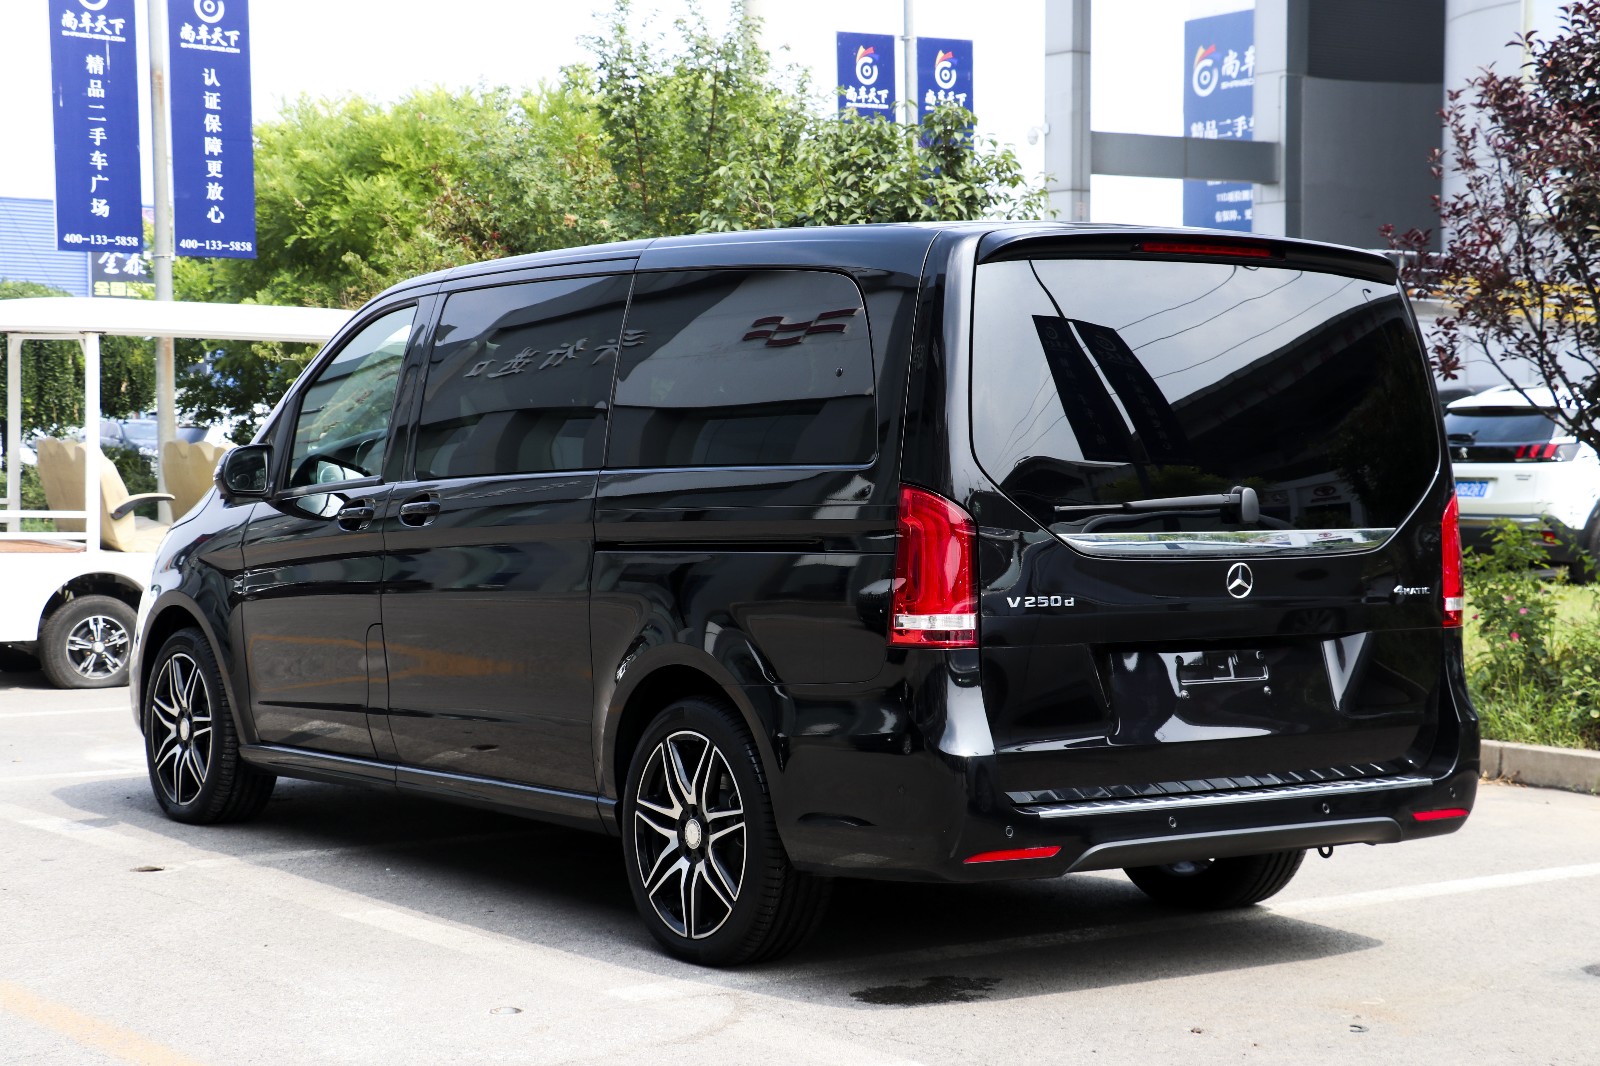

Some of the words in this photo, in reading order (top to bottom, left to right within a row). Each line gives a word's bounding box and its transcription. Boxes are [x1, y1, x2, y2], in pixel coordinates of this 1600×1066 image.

[86, 54, 110, 218] 精品二手车广场
[202, 68, 225, 224] 认证保障更放心
[64, 233, 138, 247] 400-133-5858
[180, 238, 252, 252] 400-133-5858
[1393, 585, 1430, 595] 4MATIC
